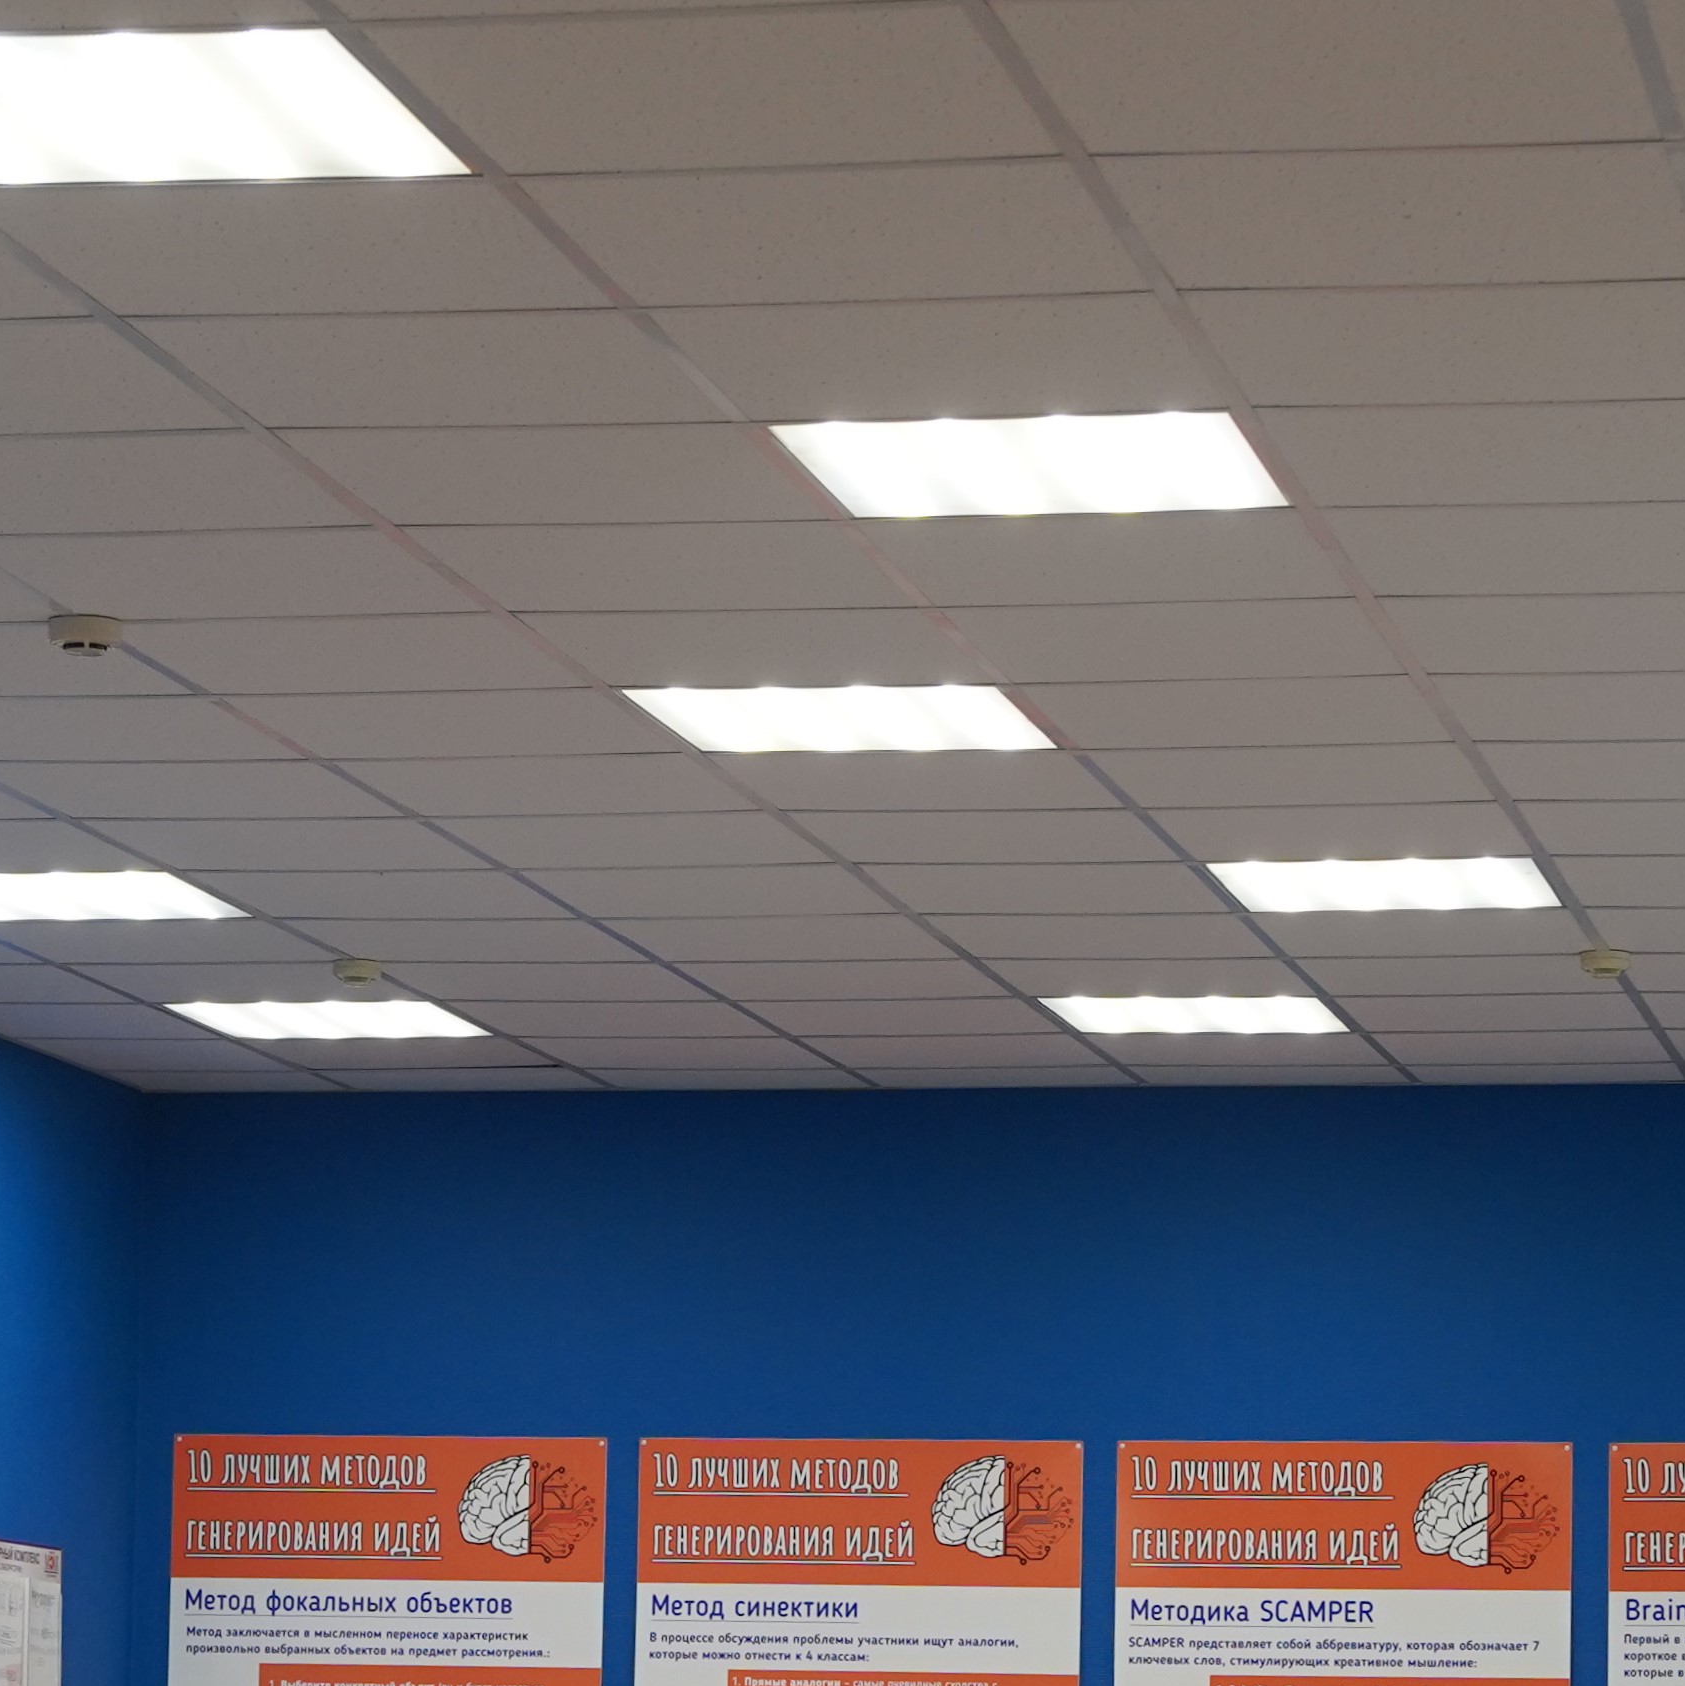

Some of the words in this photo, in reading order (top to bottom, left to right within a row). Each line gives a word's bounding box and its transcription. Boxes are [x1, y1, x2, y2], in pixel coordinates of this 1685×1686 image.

[186, 1449, 212, 1483] 10
[221, 1453, 311, 1484] ЛУЧШИХ
[319, 1454, 426, 1490] МЕТОДОВ
[652, 1452, 678, 1487] 10
[688, 1457, 780, 1493] ЛУЧШИХ
[789, 1458, 899, 1494] МЕТОДОВ
[1131, 1455, 1157, 1496] 10
[1166, 1460, 1261, 1496] ЛУЧШИХ
[1271, 1460, 1383, 1497] МЕТОДОВ
[1623, 1457, 1650, 1493] 10
[186, 1520, 363, 1551] ГЕНЕРИРОВАНИЯ
[373, 1515, 440, 1556] ИДЕЙ
[652, 1524, 834, 1560] ГЕНЕРИРОВАНИЯ
[844, 1520, 913, 1562] ИДЕЙ
[1131, 1528, 1317, 1565] ГЕНЕРИРОВАНИЯ
[1328, 1523, 1398, 1566] ИДЕЙ
[184, 1587, 256, 1615] Метод
[265, 1588, 397, 1616] фокальных
[405, 1590, 513, 1614] объектов
[650, 1593, 725, 1620] Метод
[733, 1599, 858, 1618] синектики
[1130, 1598, 1249, 1625] Методика
[1259, 1599, 1374, 1623] SCAMPER
[185, 1625, 223, 1638] Метод
[225, 1628, 300, 1638] заключается
[302, 1629, 310, 1638] в
[313, 1629, 382, 1639] мысленном
[385, 1630, 439, 1642] переносе
[441, 1631, 528, 1643] характеристик
[648, 1631, 657, 1642] В
[660, 1633, 714, 1645] процессе
[717, 1631, 789, 1646] обсуждения
[791, 1633, 854, 1646] проблемы
[856, 1636, 919, 1647] участники
[922, 1637, 954, 1649] ищут
[956, 1637, 1020, 1648] аналогии,
[1127, 1635, 1185, 1648] SCAMPER
[1188, 1639, 1272, 1650] представляет
[1275, 1637, 1312, 1649] собой
[1314, 1638, 1403, 1653] аббревиатуру,
[1405, 1641, 1455, 1653] которая
[1458, 1639, 1529, 1651] обозначает
[1532, 1639, 1540, 1651] 7
[1622, 1632, 1670, 1646] Первый
[1672, 1635, 1681, 1644] в
[184, 1644, 261, 1656] произвольно
[263, 1642, 330, 1656] выбранных
[332, 1643, 387, 1655] объектов
[389, 1647, 405, 1656] на
[407, 1647, 458, 1658] предмет
[647, 1650, 698, 1661] которые
[701, 1651, 741, 1660] можно
[743, 1651, 791, 1661] отнести
[794, 1652, 802, 1660] к
[804, 1650, 813, 1660] 4
[816, 1652, 870, 1662] классам:
[1127, 1655, 1190, 1665] ключевых
[1192, 1656, 1227, 1666] слов,
[1228, 1656, 1330, 1669] стимулирующих
[1332, 1658, 1404, 1669] креативное
[1406, 1658, 1478, 1668] мышление:
[1622, 1652, 1677, 1663] короткое
[1622, 1668, 1674, 1680] которые
[1676, 1669, 1684, 1677] в
